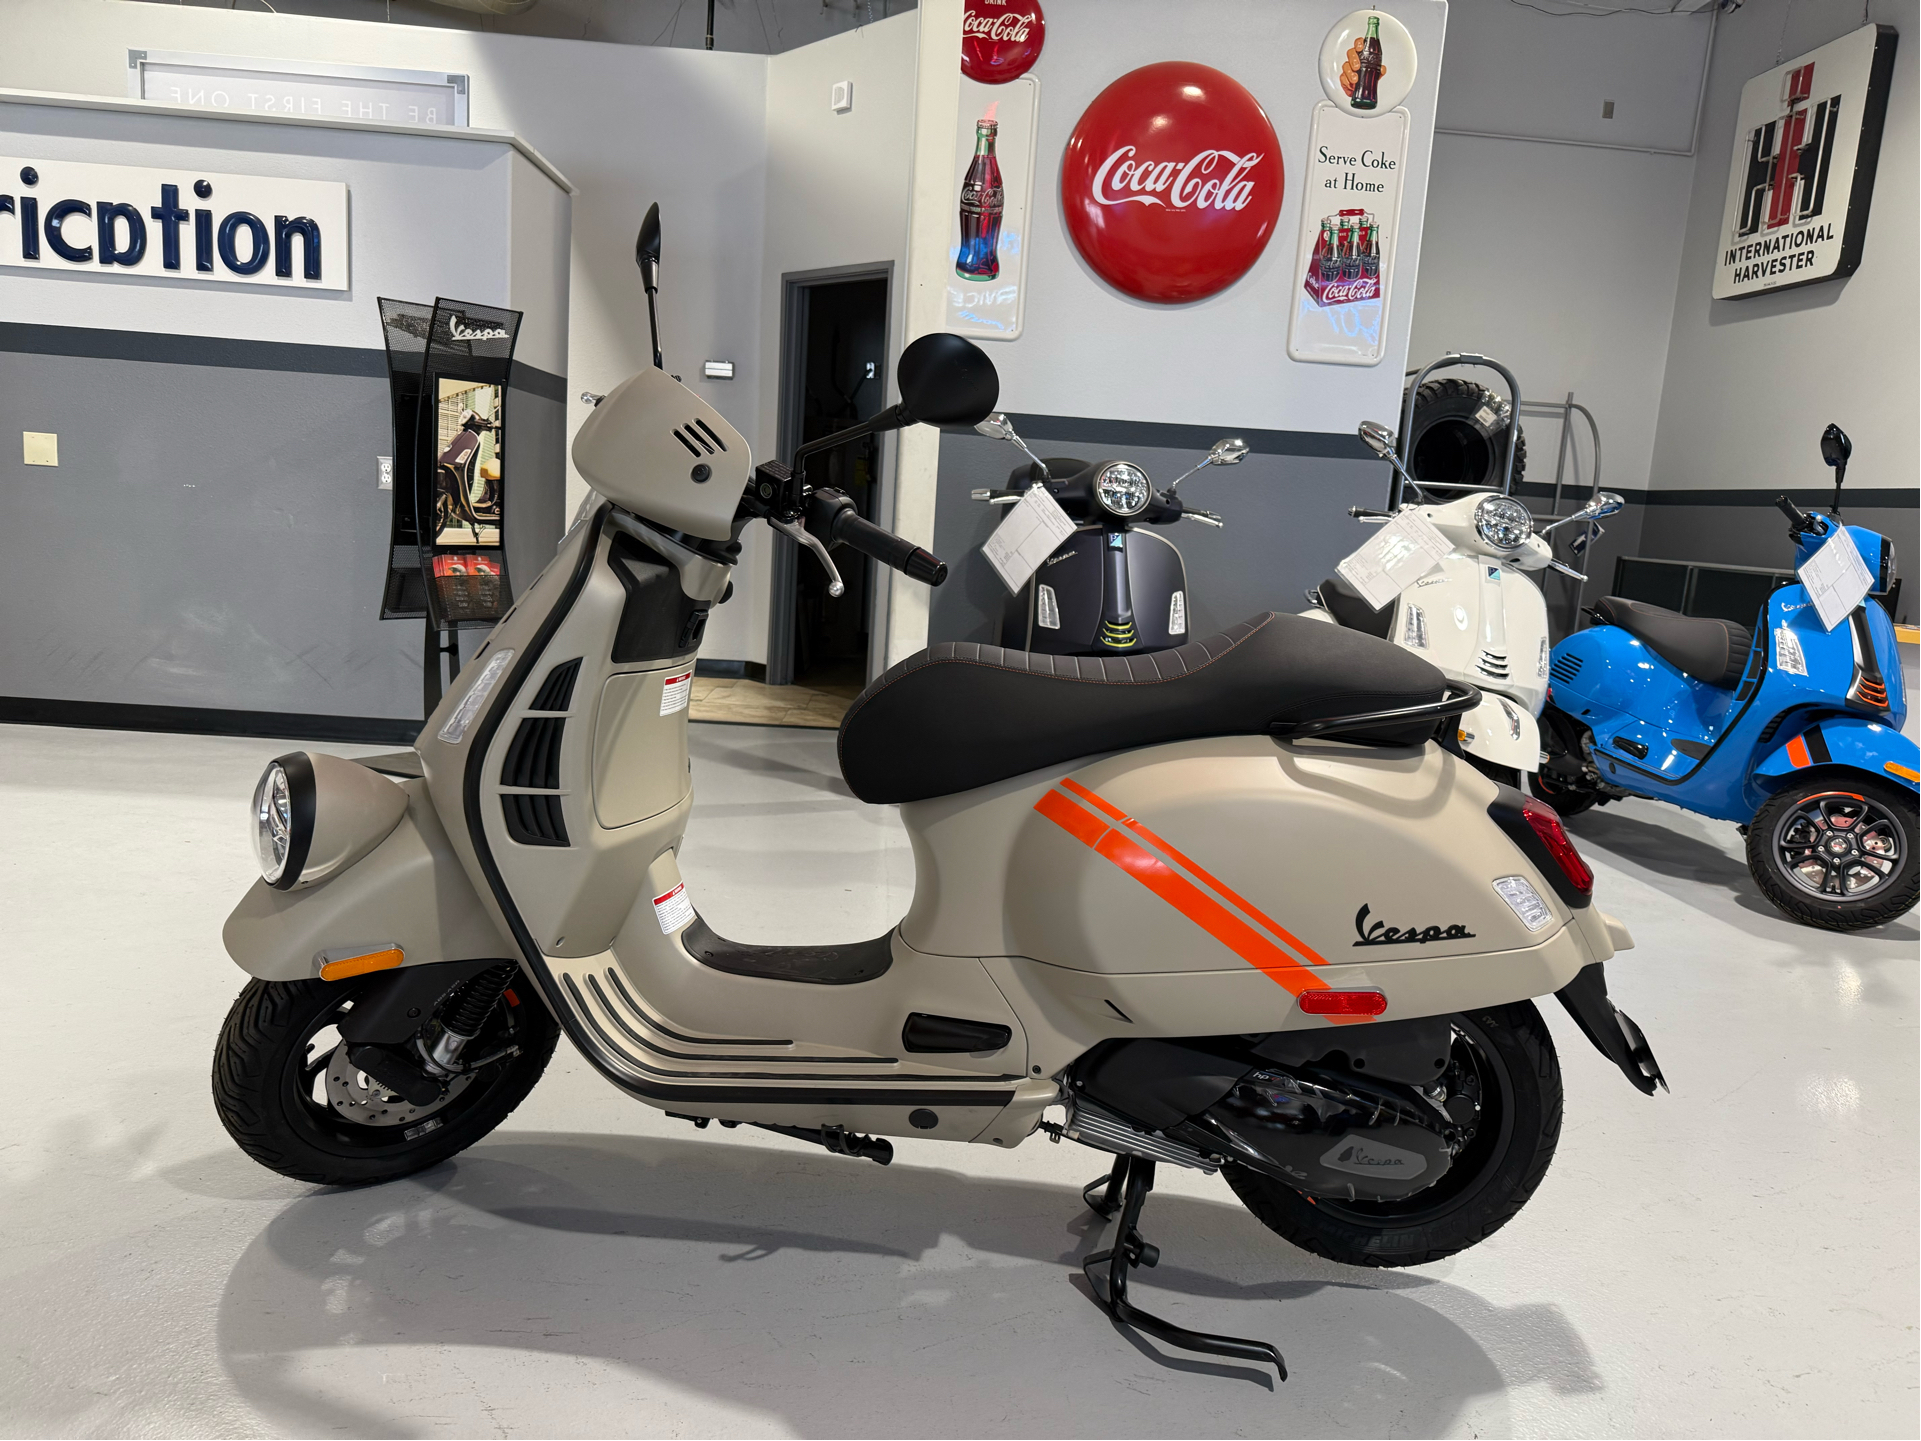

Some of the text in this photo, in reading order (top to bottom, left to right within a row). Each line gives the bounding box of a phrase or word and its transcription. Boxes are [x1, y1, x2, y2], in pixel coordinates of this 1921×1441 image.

[1317, 145, 1397, 170] Serve Coke
[1092, 145, 1265, 211] Coca-Cola
[1324, 172, 1385, 193] at Home
[1724, 222, 1835, 267] INTERNATIONAL
[1733, 249, 1816, 285] HARVESTER
[1322, 278, 1378, 303] Coca-Cola
[450, 315, 510, 341] Vespa
[1352, 902, 1477, 947] Vespa
[1354, 1147, 1405, 1166] Vespa
